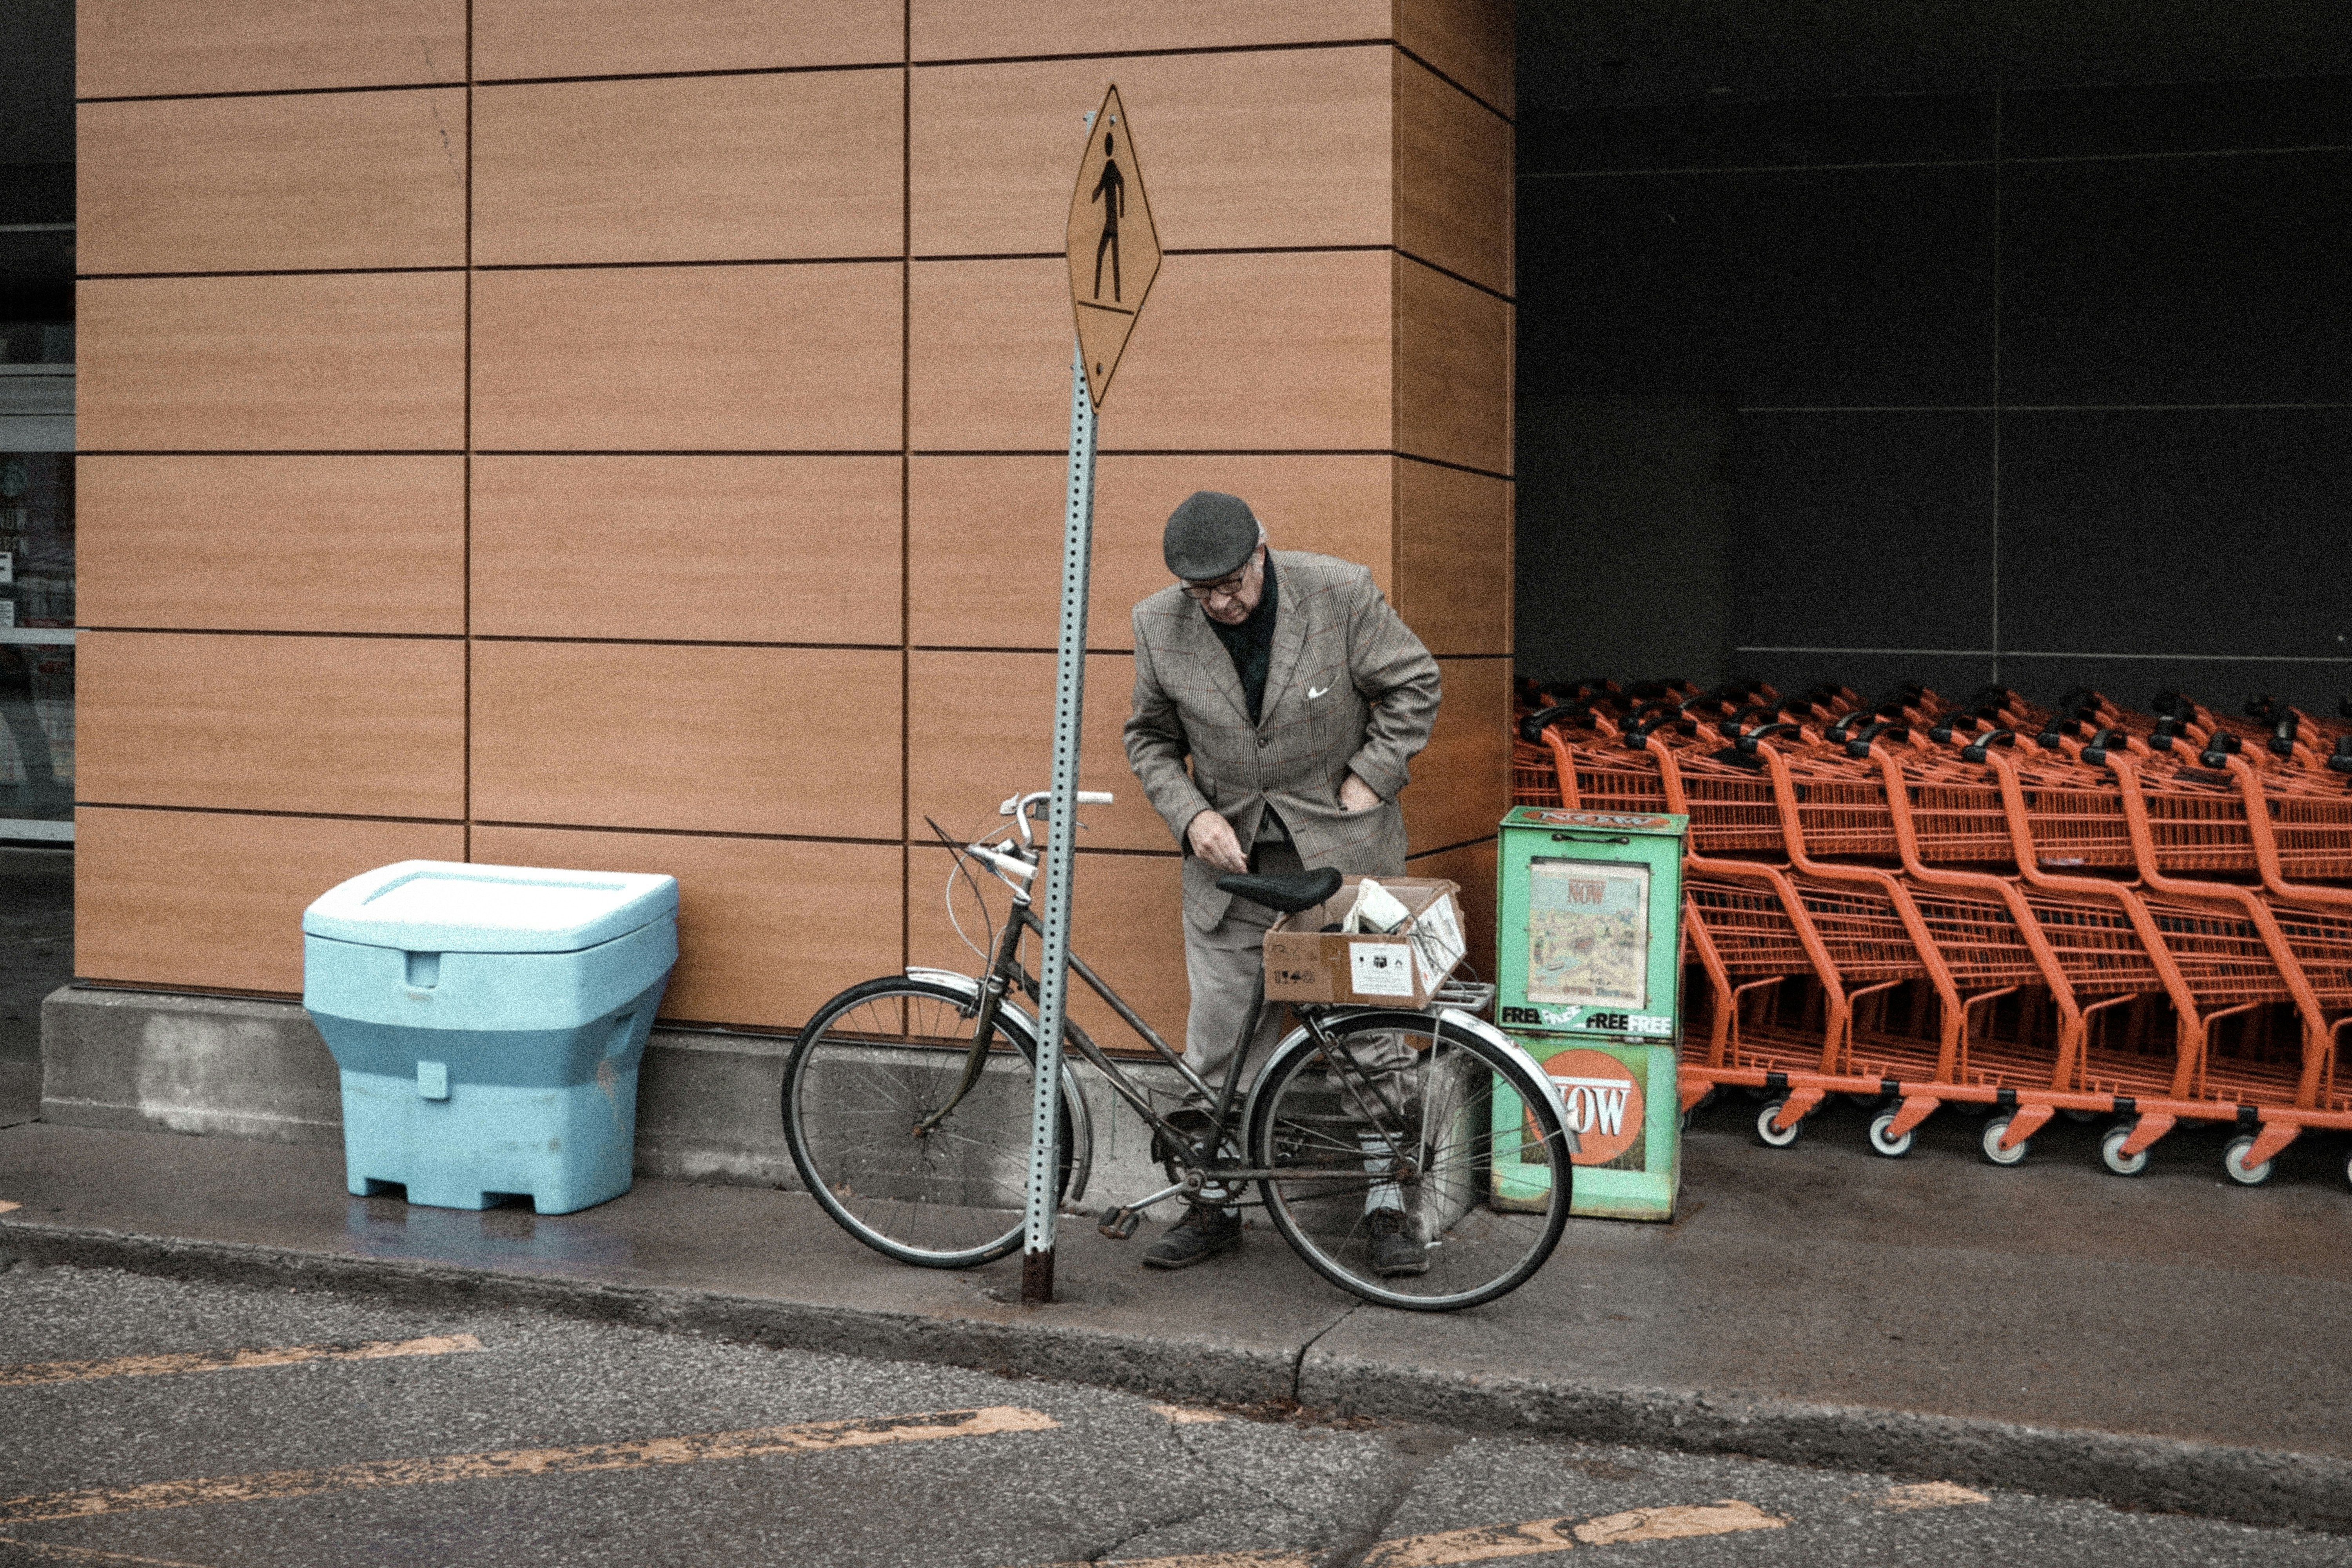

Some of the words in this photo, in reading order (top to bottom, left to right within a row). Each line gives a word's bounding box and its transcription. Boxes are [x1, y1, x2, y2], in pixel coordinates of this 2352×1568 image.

[1567, 882, 1605, 904] NOW
[1586, 1013, 1628, 1031] FREE
[1628, 1014, 1672, 1034] FREE
